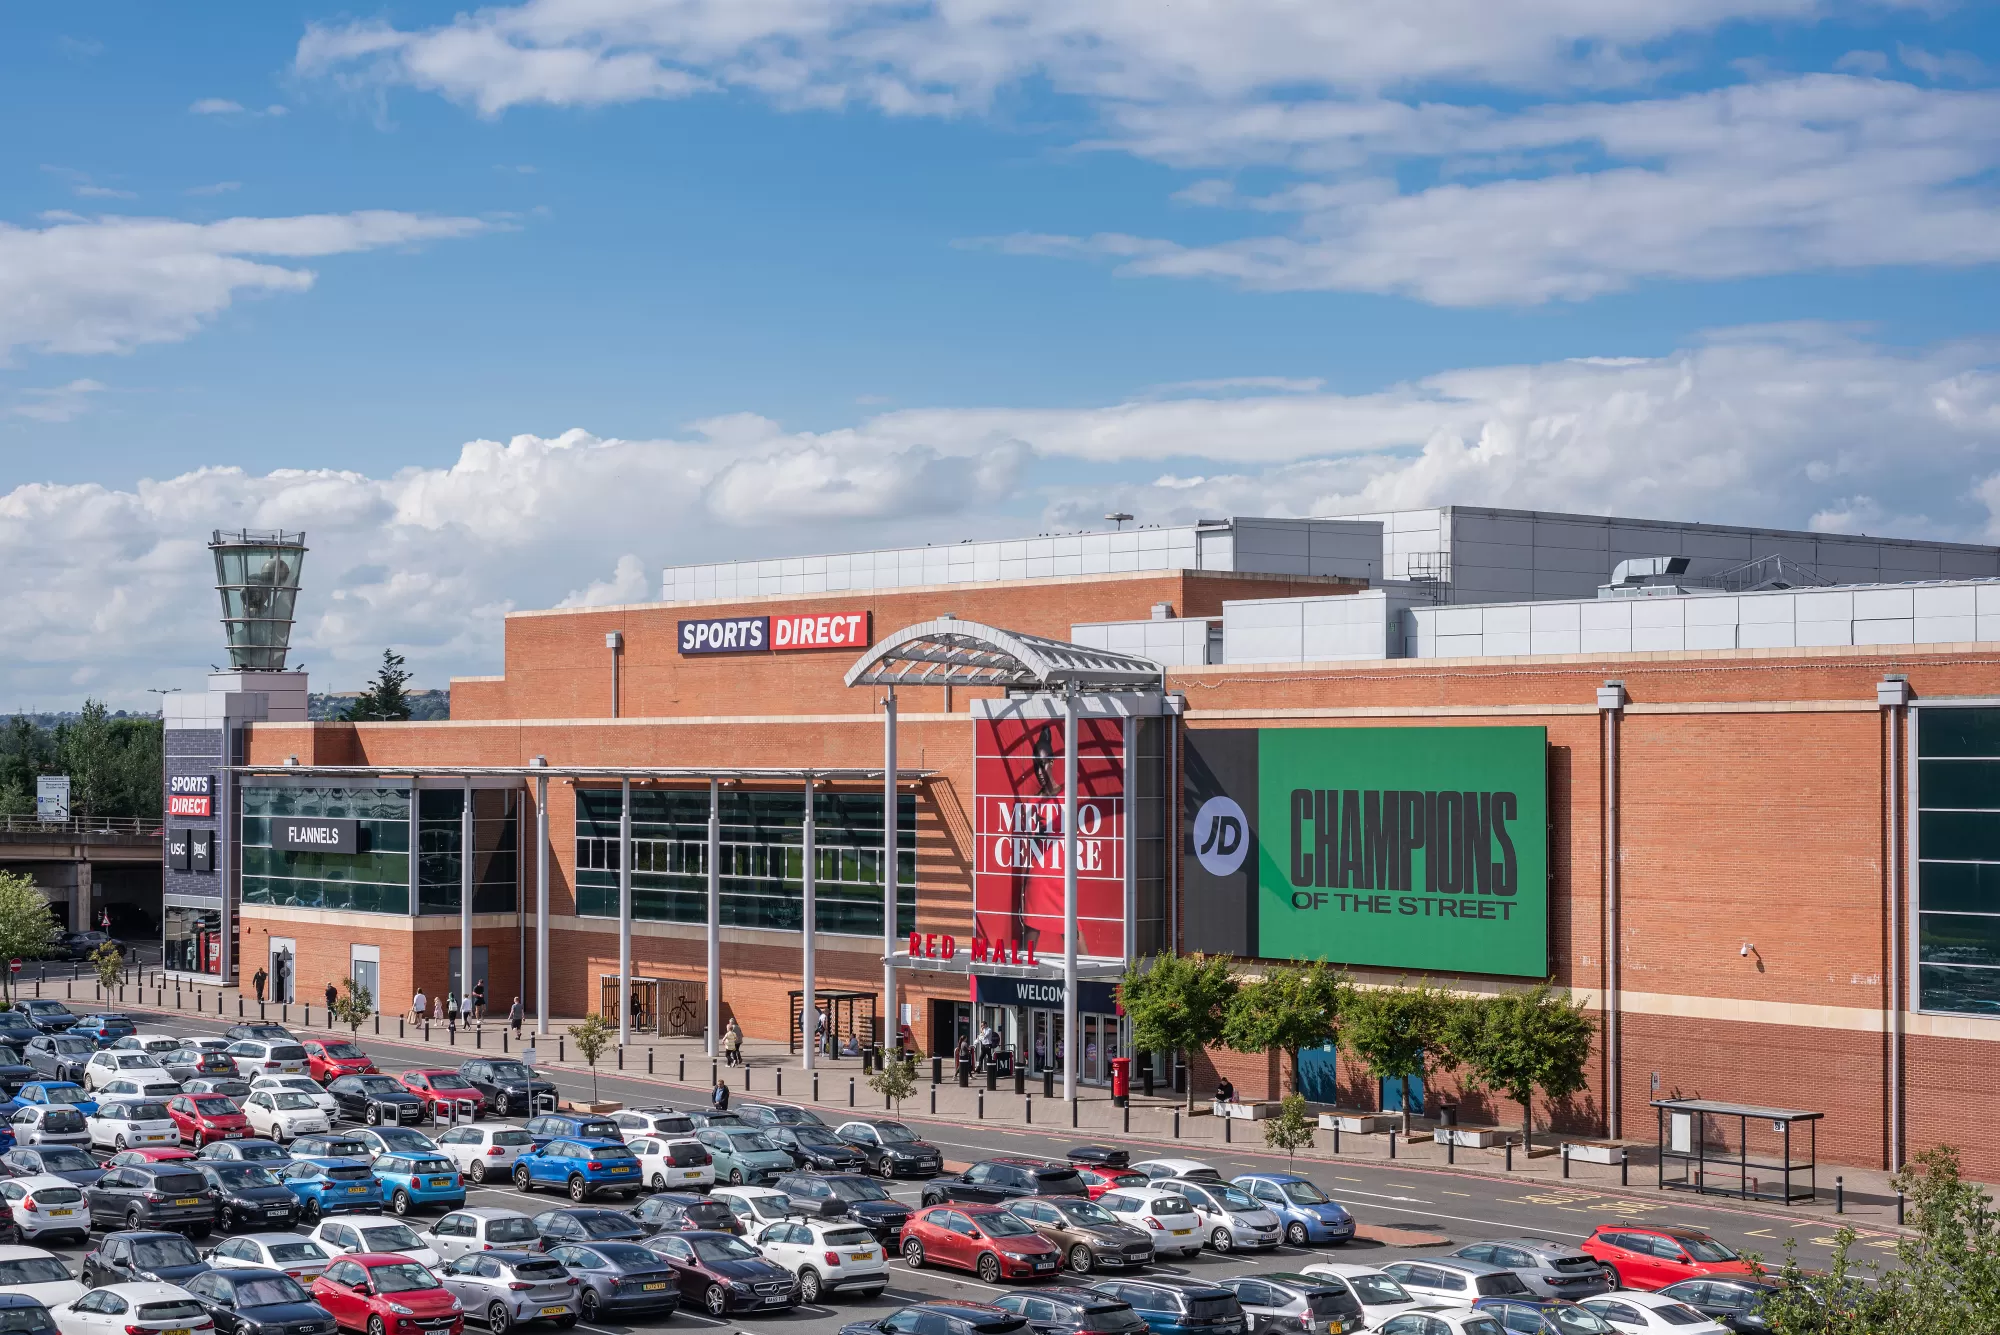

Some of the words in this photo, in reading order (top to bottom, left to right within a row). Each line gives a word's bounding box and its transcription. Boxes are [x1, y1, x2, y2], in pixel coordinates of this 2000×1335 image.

[682, 620, 763, 650] SPORTS
[775, 615, 861, 646] DIRECT
[171, 776, 208, 792] SPORTS
[171, 797, 208, 814] DIRECT
[997, 802, 1102, 835] METO
[170, 842, 186, 855] USC
[288, 826, 339, 845] FLANNELS
[1200, 815, 1242, 856] JD
[1290, 788, 1518, 897] CHAMPIONS
[1291, 891, 1329, 910] OF
[1334, 893, 1392, 914] THE
[1397, 896, 1518, 921] STREET
[908, 931, 956, 960] RED
[970, 936, 1039, 966] MALL
[1016, 983, 1066, 1003] WELCOM
